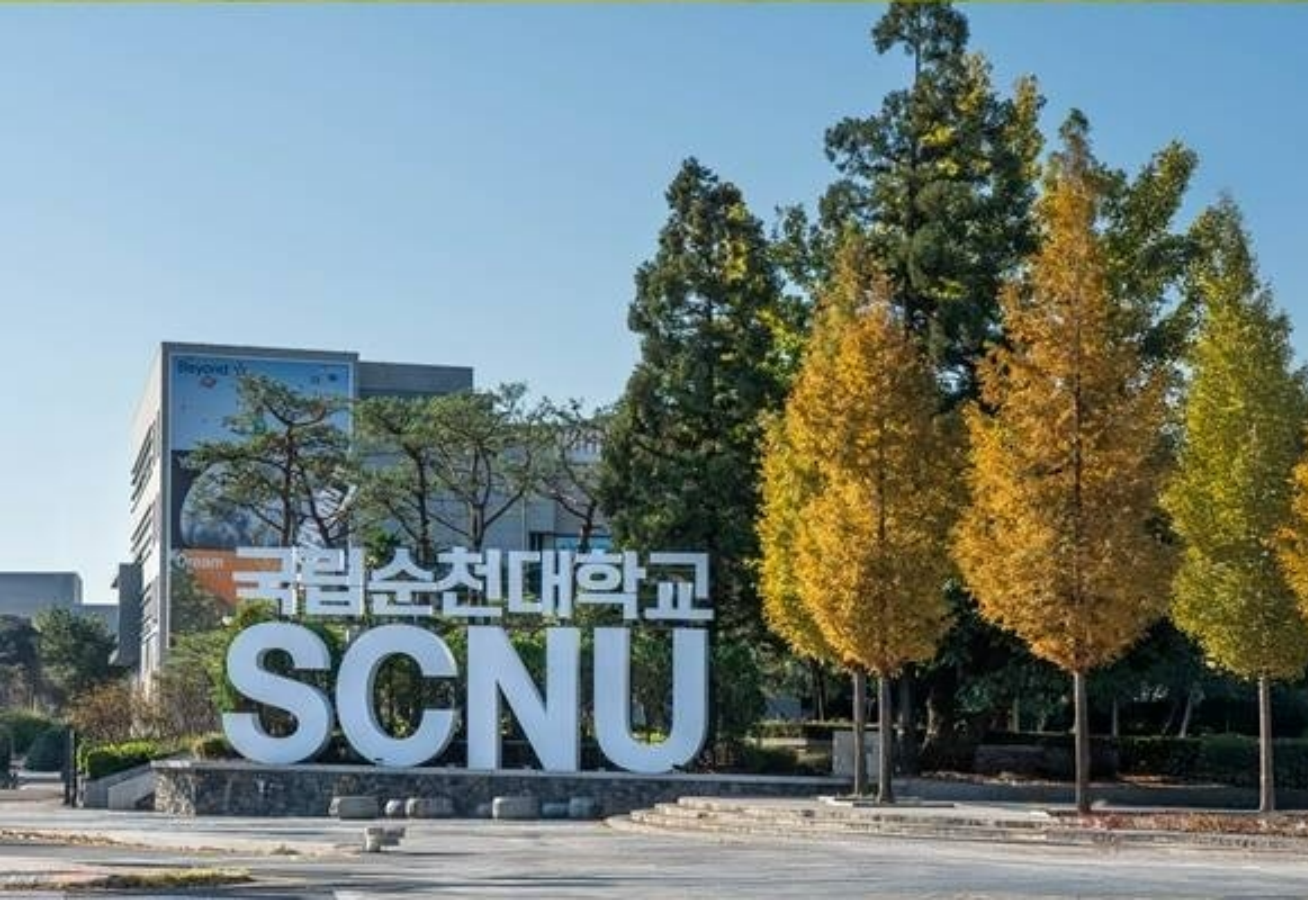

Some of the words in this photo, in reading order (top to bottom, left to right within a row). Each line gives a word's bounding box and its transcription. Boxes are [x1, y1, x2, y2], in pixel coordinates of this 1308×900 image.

[177, 359, 229, 376] Beyond
[232, 546, 715, 619] 국립순천대학교
[222, 623, 709, 773] SCNU
